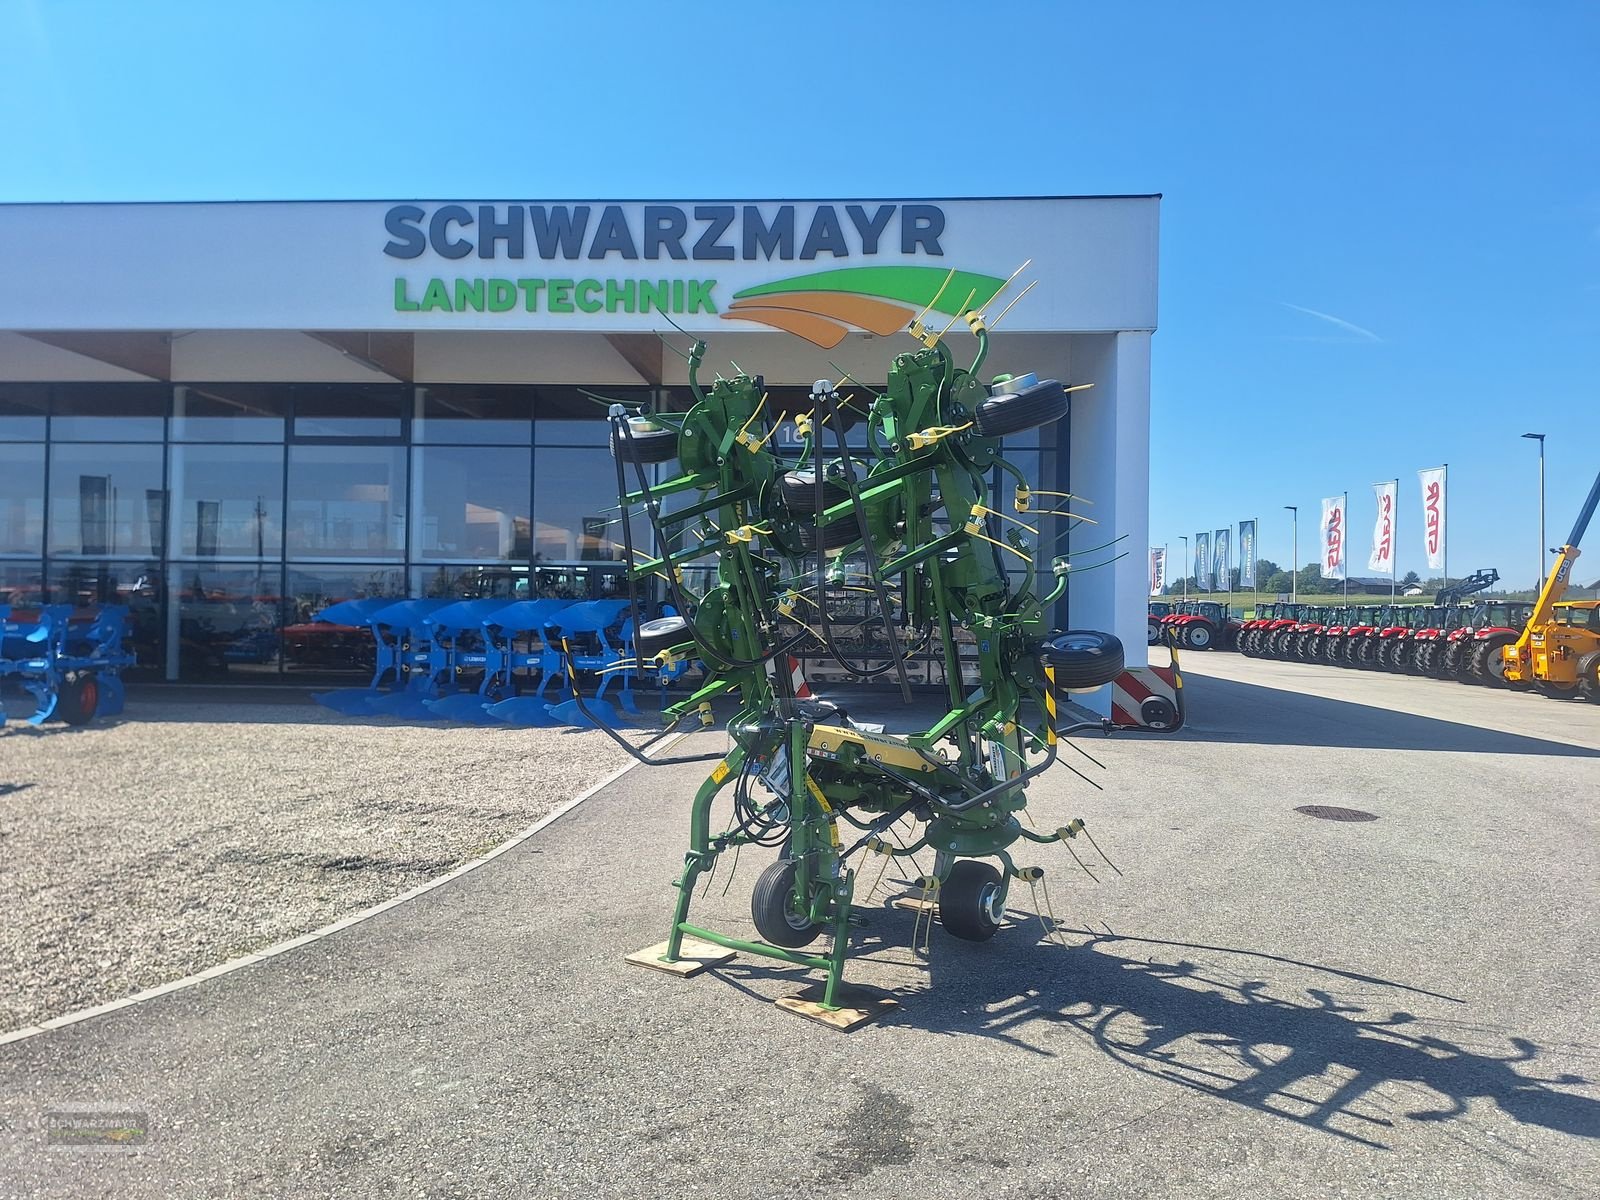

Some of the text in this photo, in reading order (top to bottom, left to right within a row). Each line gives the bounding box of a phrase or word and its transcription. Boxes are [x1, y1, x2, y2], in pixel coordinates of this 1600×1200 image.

[383, 204, 946, 261] SCHWARZMAYR
[394, 278, 718, 314] LANDTECHNIK
[1557, 560, 1570, 582] JCB
